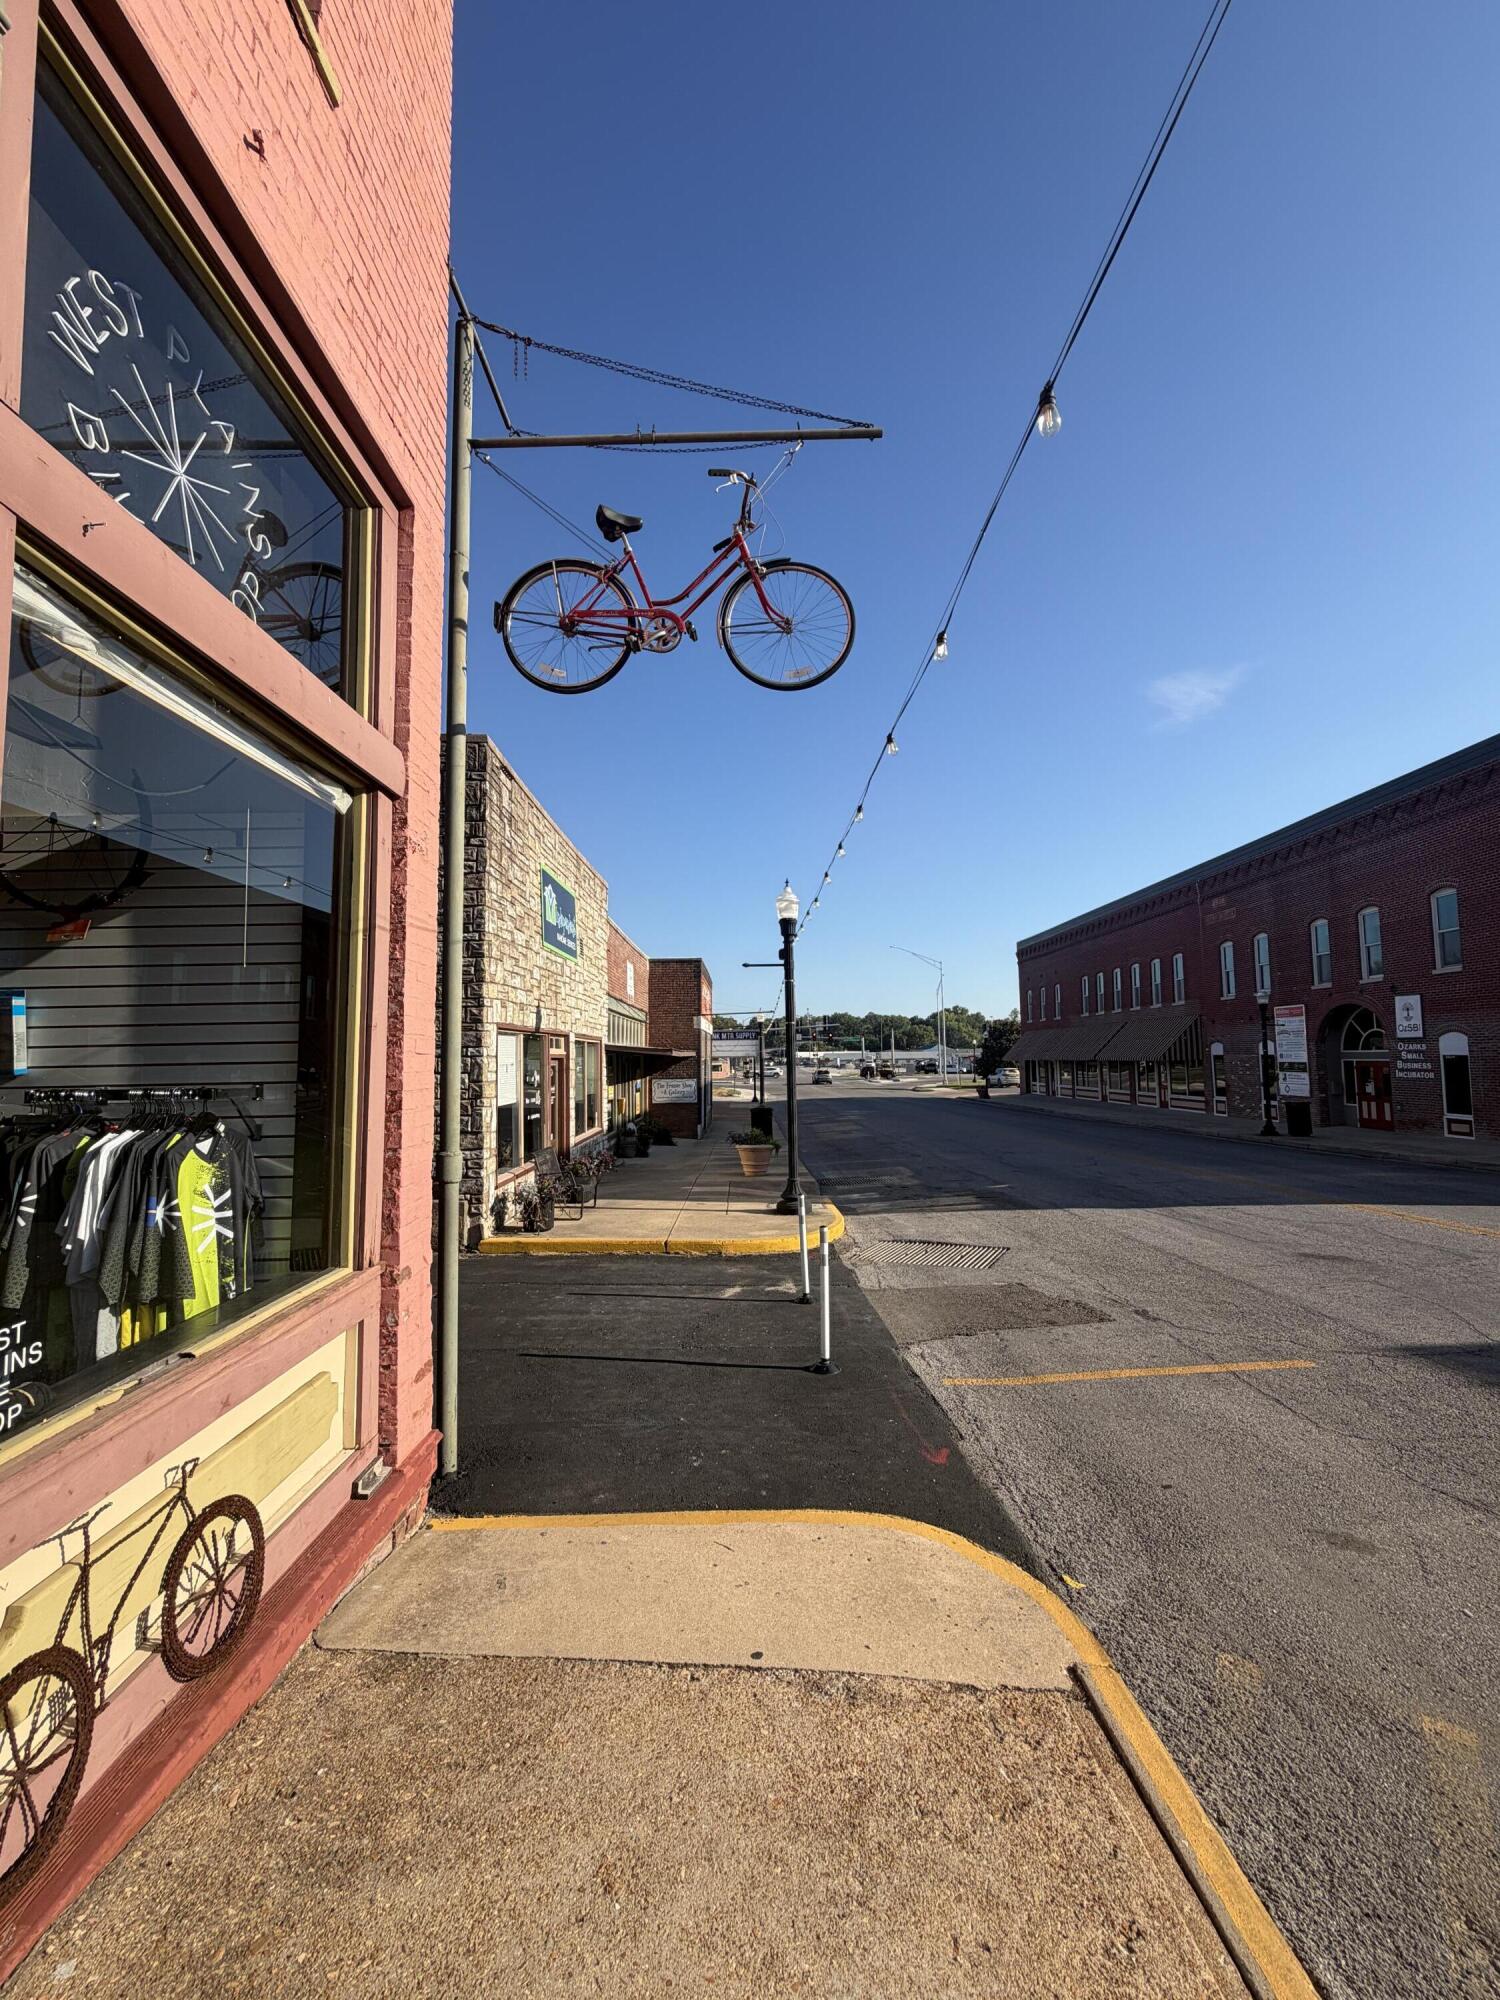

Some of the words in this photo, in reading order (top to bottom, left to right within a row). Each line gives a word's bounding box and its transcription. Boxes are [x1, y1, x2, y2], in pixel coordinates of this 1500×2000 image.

[48, 270, 142, 375] WEST
[167, 325, 273, 559] PLAINS
[735, 1031, 757, 1040] SUPPLY
[1397, 1042, 1427, 1050] OZARKS
[1401, 1051, 1424, 1060] SMALL
[1397, 1060, 1432, 1069] BUSINESS
[1395, 1069, 1435, 1079] INCUBATOR
[3, 1341, 43, 1376] INS
